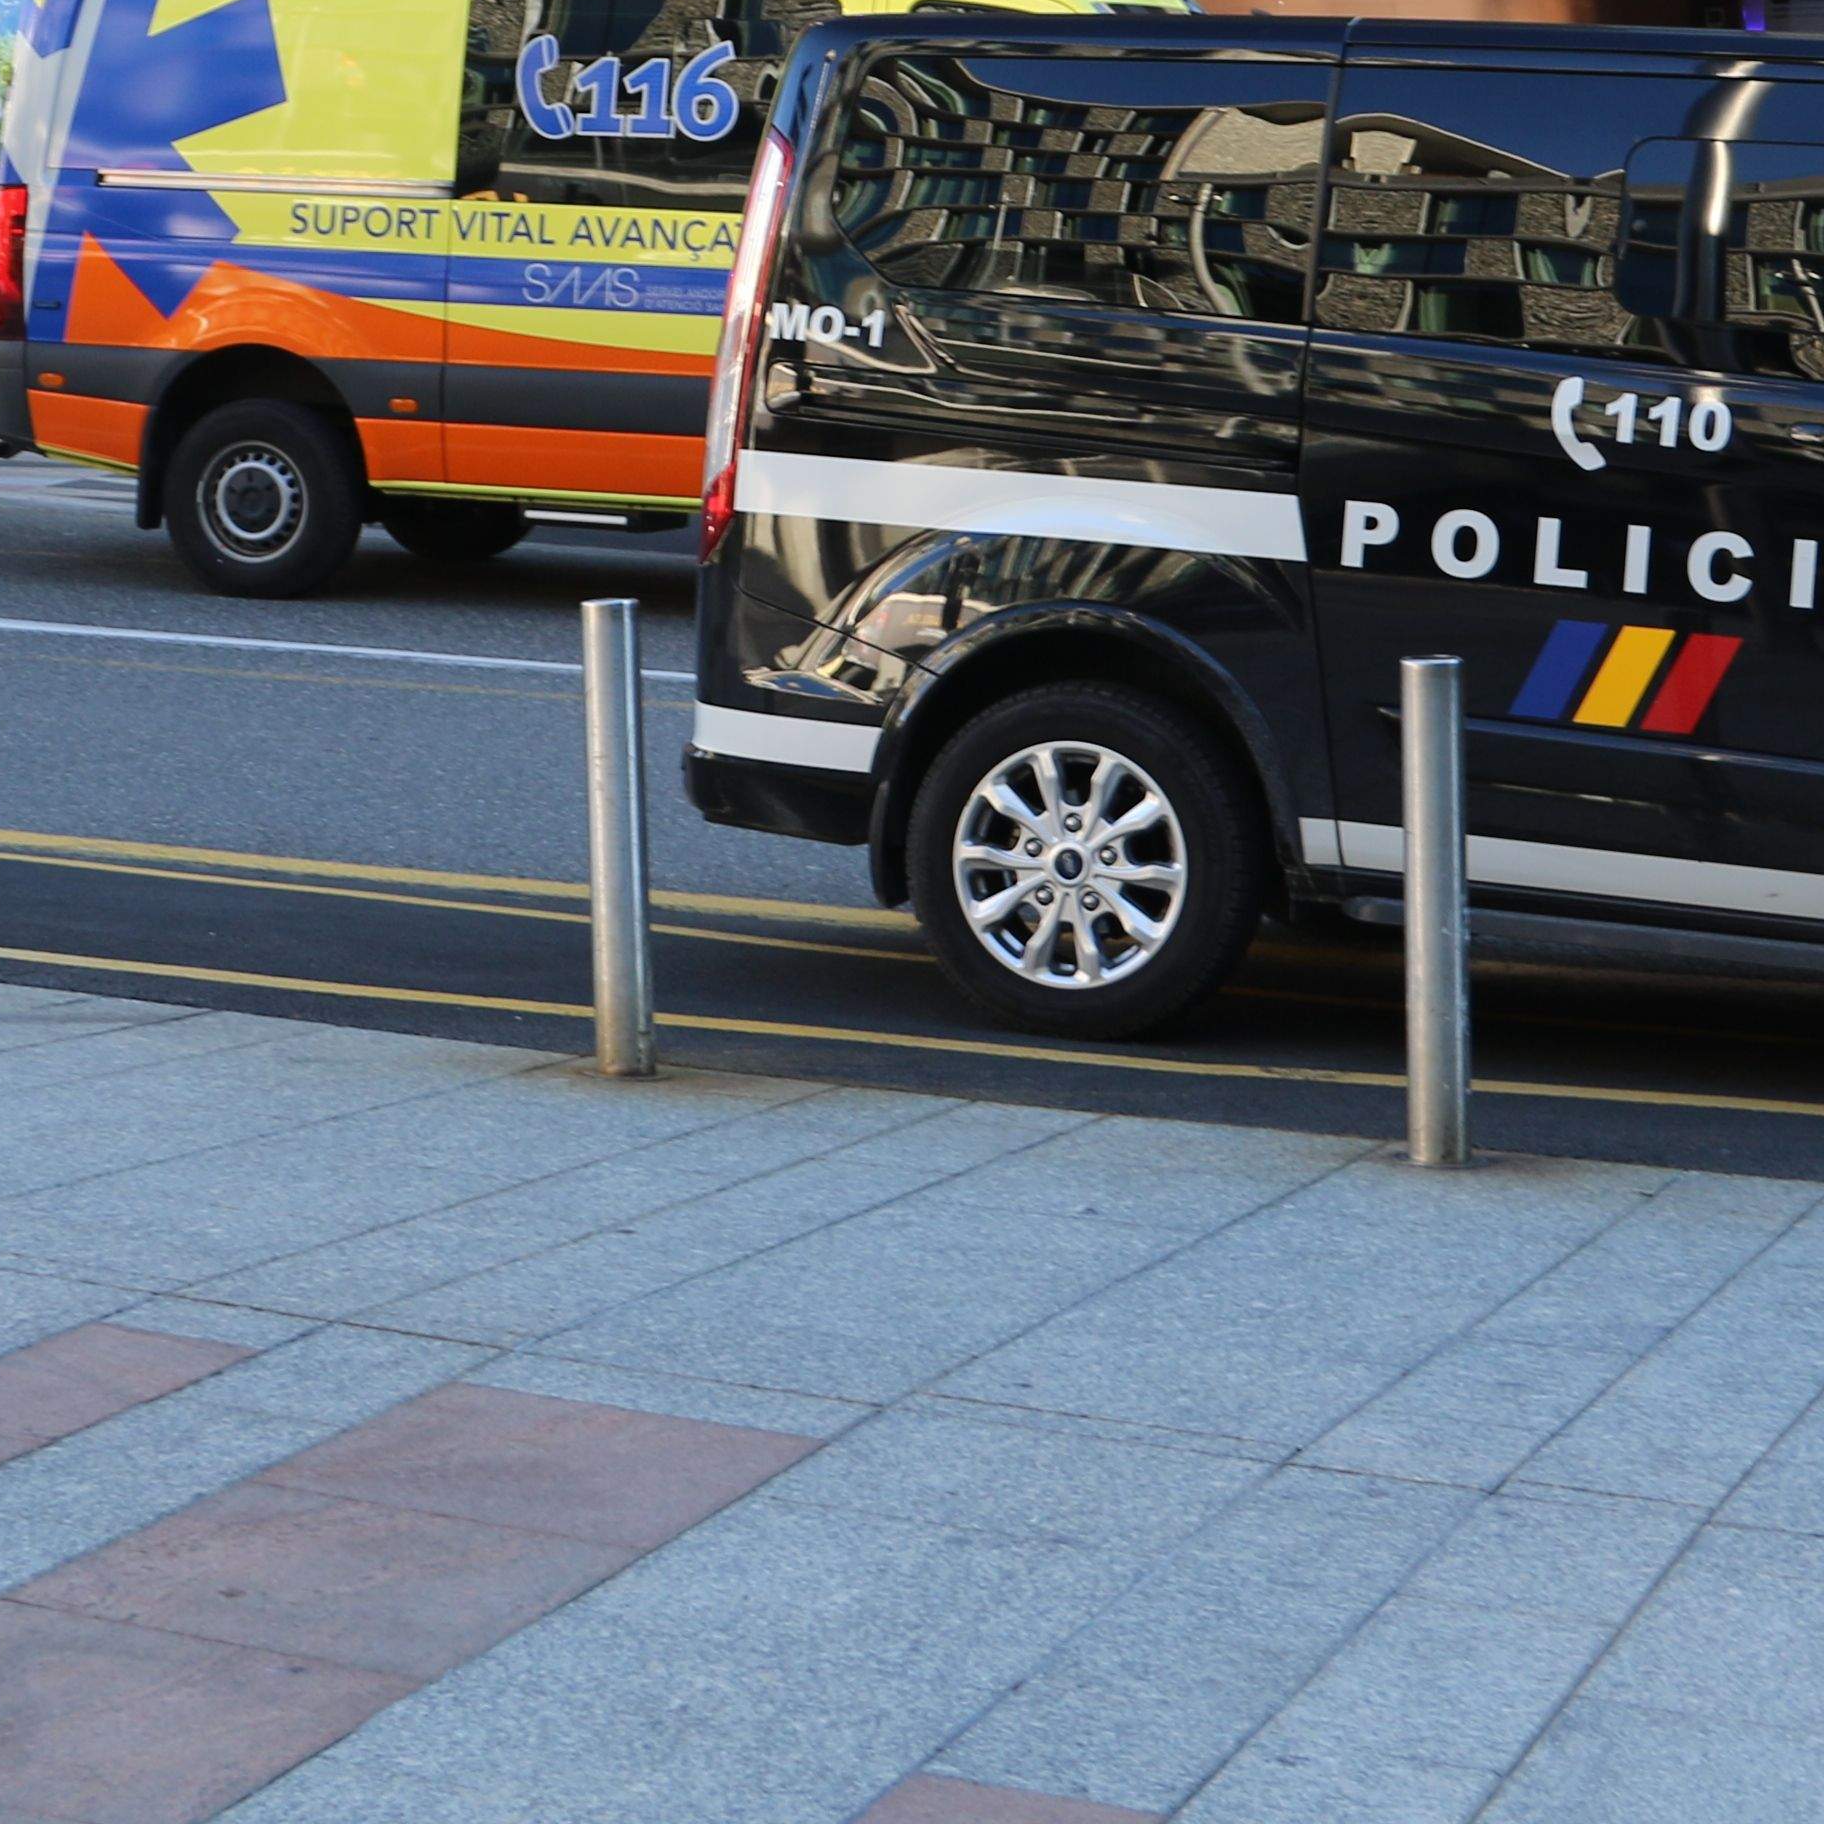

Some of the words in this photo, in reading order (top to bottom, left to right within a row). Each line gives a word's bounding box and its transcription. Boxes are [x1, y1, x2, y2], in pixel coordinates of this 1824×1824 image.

[576, 39, 740, 142] 116
[289, 201, 443, 241] SUPORT
[452, 208, 555, 245] VITAL
[771, 302, 887, 349] MO-1
[1603, 392, 1733, 453] 110
